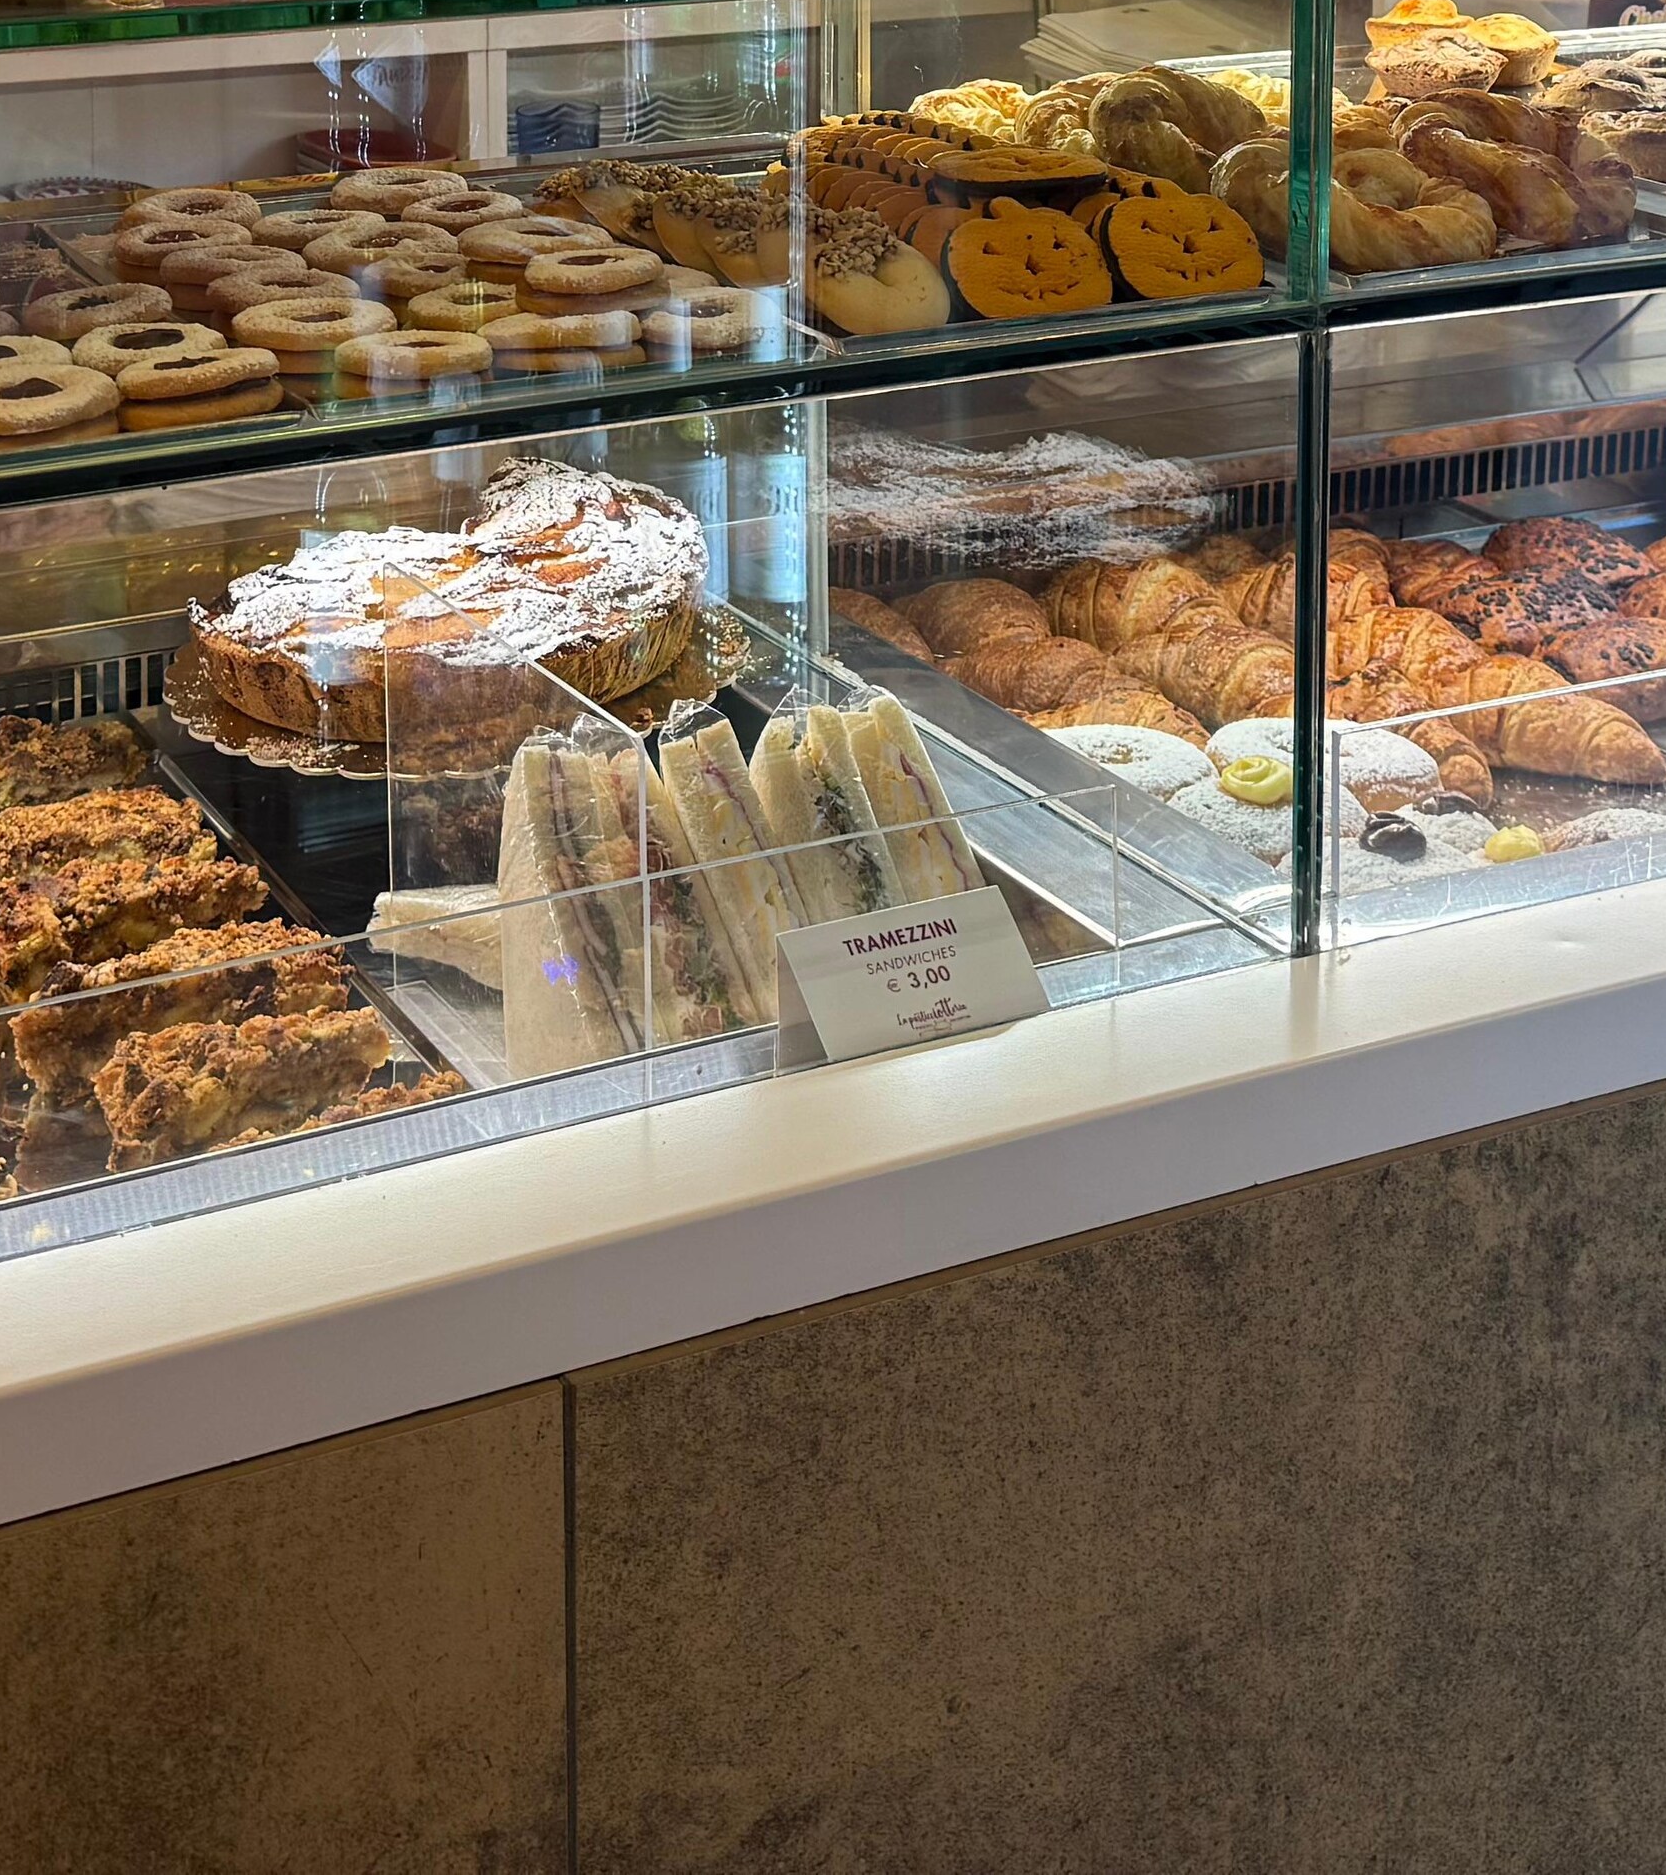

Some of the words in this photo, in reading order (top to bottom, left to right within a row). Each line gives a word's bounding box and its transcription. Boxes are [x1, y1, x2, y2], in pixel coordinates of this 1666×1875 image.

[842, 918, 958, 957] TRAMEZZINI
[866, 945, 957, 975] SANDWICHES
[887, 978, 901, 992] €
[907, 965, 951, 989] 3,00
